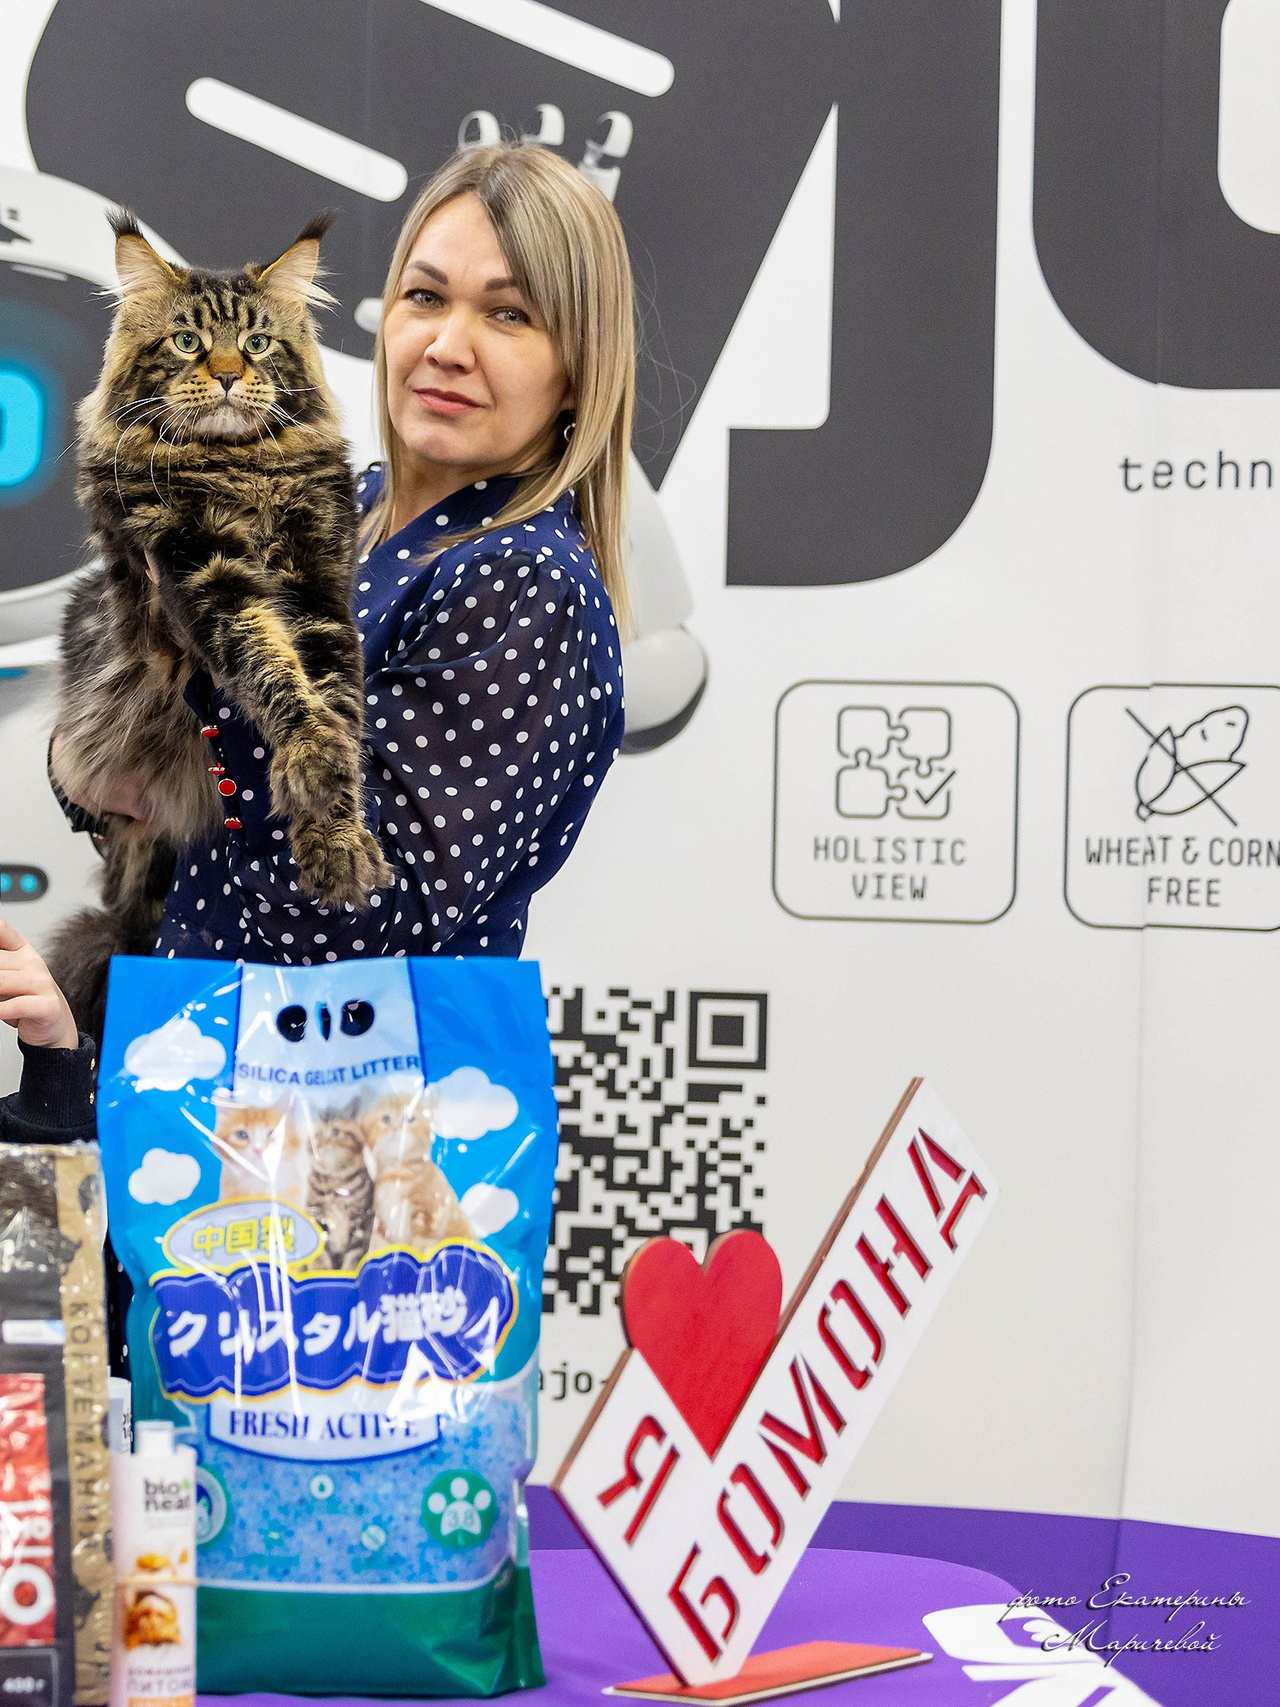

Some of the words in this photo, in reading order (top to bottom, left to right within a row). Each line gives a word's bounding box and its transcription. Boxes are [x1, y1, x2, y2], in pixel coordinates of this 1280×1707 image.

[1119, 451, 1273, 492] techn
[813, 836, 967, 866] HOLISTIC
[1085, 835, 1172, 867] WHEAT
[1182, 836, 1199, 866] &
[1208, 837, 1280, 867] CORN
[852, 874, 927, 900] VIEW
[1147, 876, 1221, 908] FREE
[238, 1063, 301, 1085] SILICA
[351, 1054, 419, 1081] LITTER
[667, 1127, 987, 1664] БОМОНД
[228, 1410, 311, 1438] FRESH
[144, 1480, 180, 1495] bio
[596, 1415, 680, 1545] Я
